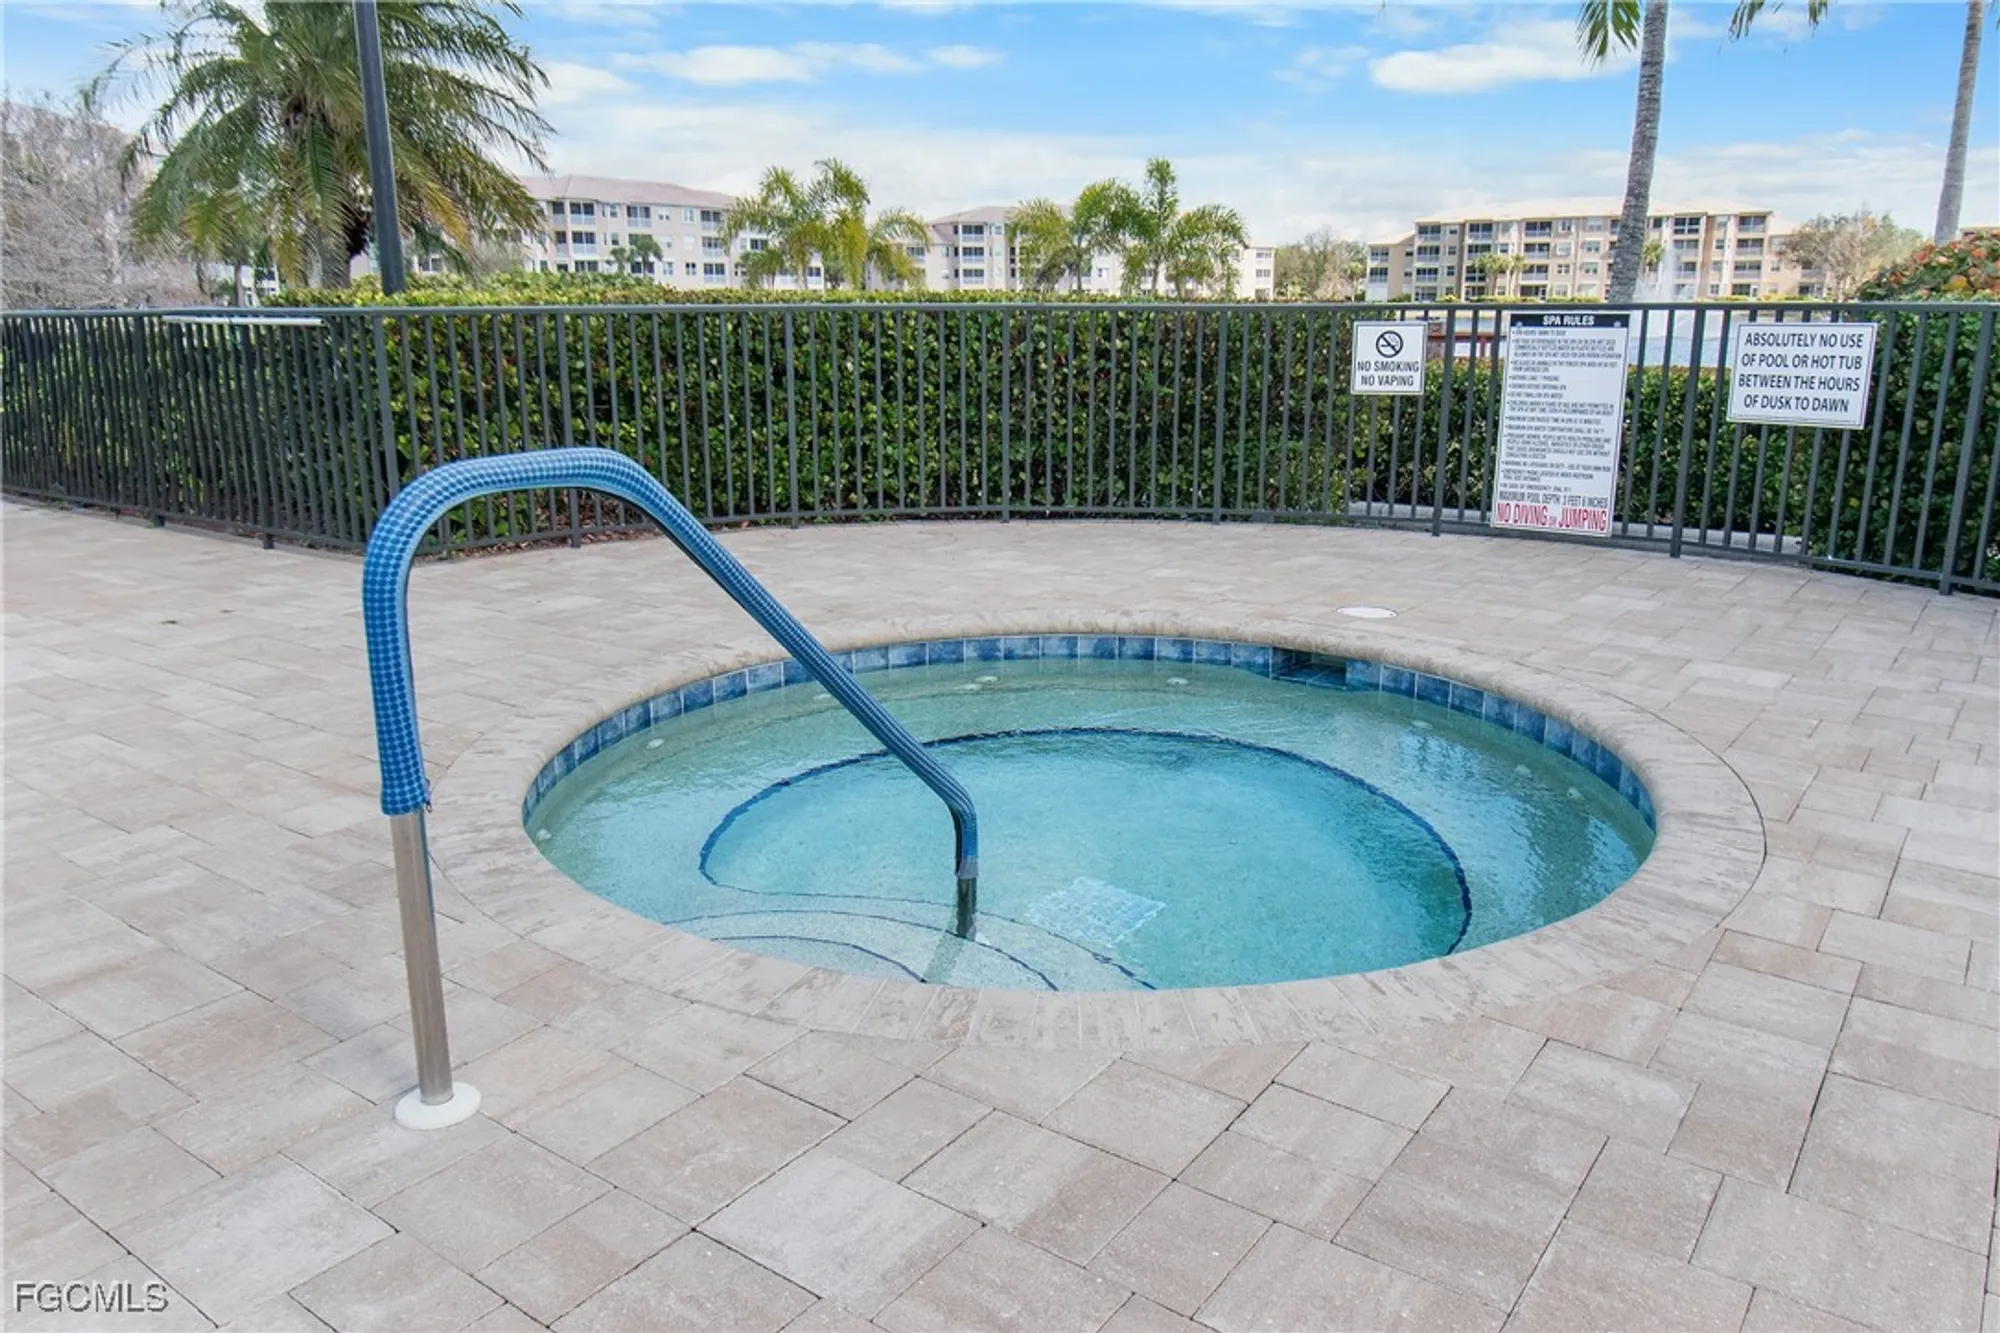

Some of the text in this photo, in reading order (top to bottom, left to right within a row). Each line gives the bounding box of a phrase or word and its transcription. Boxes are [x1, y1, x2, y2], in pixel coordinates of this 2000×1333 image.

[1543, 315, 1595, 326] SPA RULES
[1744, 332, 1864, 348] ABSOLUTELY NO USE
[1357, 361, 1419, 373] NO SMOKING
[1742, 353, 1863, 370] OF POOL OR HOT TUB
[1361, 375, 1414, 387] NO VAPING
[1739, 373, 1860, 391] BETWEEN THE HOURS
[1744, 394, 1849, 412] OF DUSK TO DAWN
[1497, 502, 1511, 523] NO
[1513, 503, 1548, 526] DIVING
[1559, 506, 1607, 532] JUMPING
